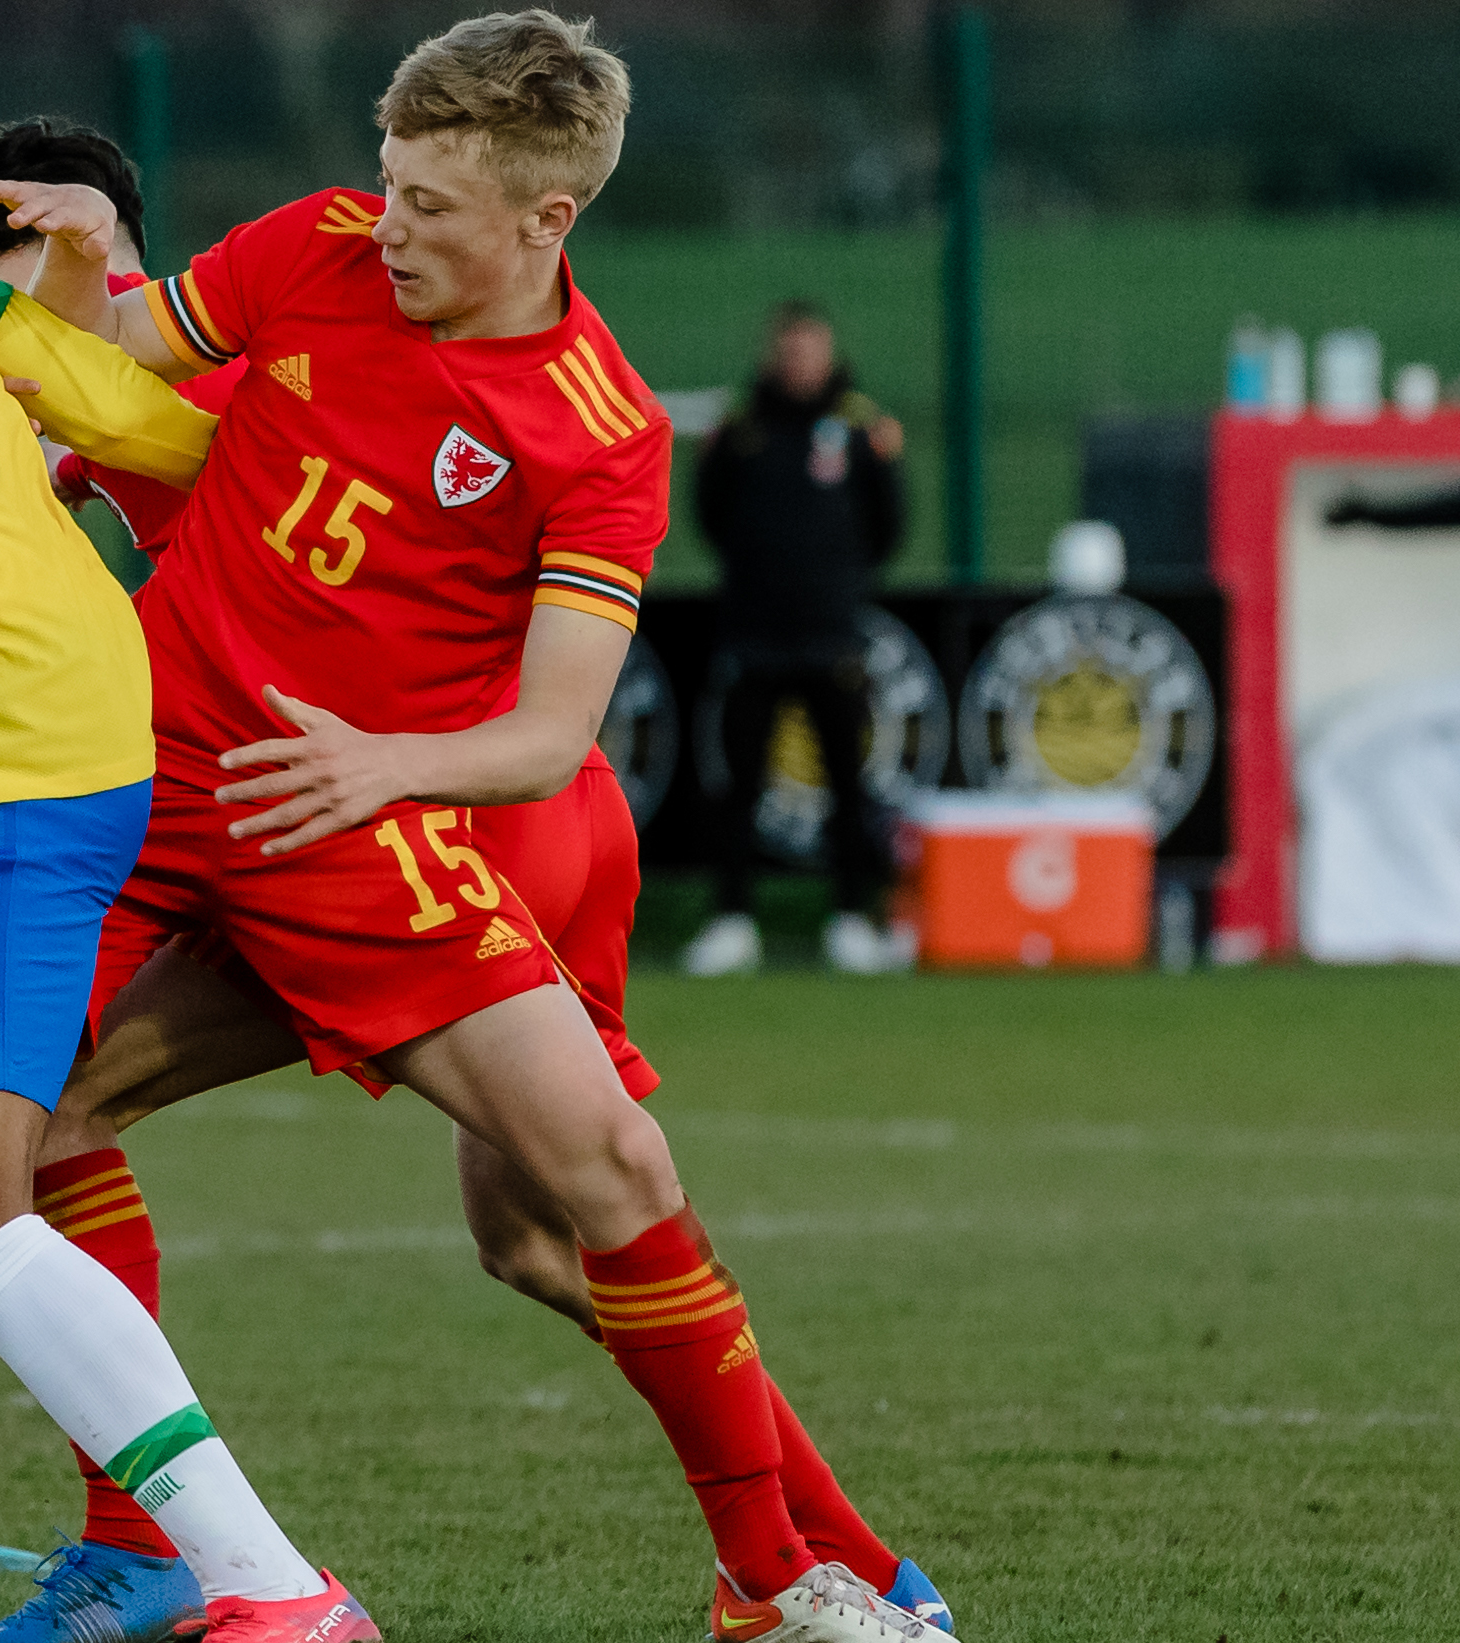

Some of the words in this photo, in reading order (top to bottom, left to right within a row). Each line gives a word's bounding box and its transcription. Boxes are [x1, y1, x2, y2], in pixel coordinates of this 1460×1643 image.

[269, 363, 312, 401] adidas
[262, 456, 393, 586] 15
[375, 810, 500, 933] 15
[476, 937, 532, 960] adidas
